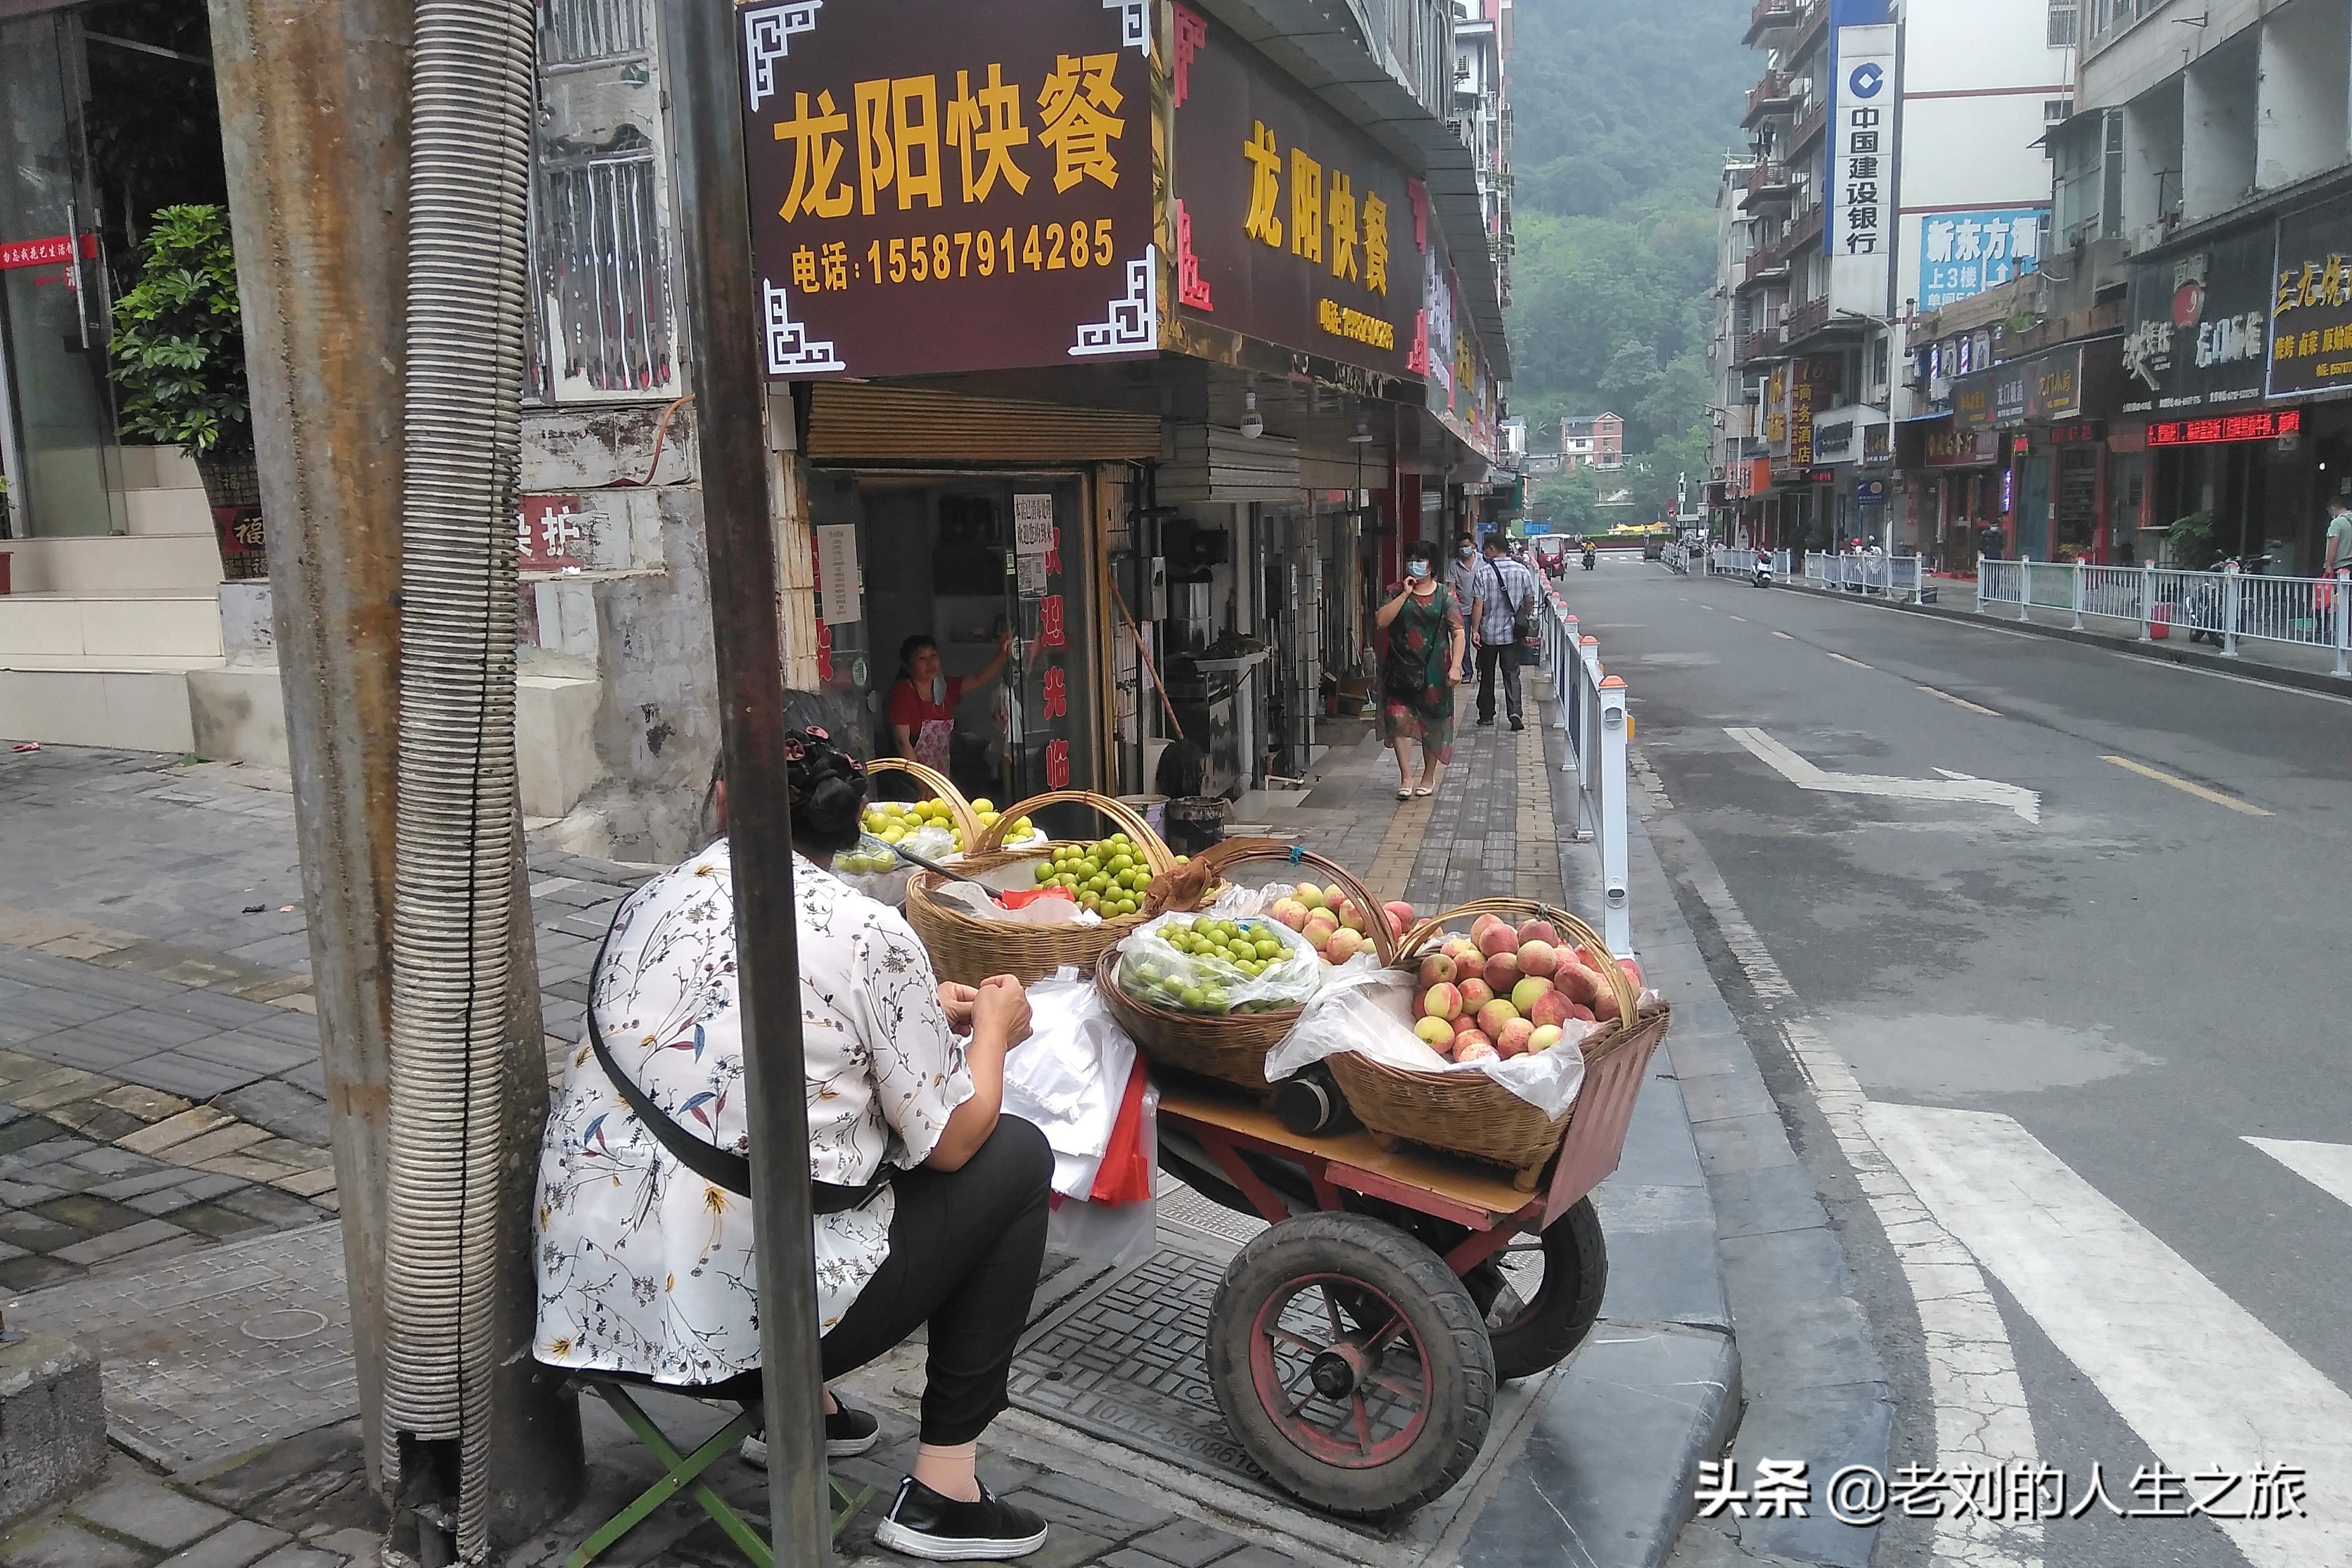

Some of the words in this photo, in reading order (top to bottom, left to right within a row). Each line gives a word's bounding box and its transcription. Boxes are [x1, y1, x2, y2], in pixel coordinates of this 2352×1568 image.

[774, 52, 1126, 223] 龙阳快餐
[1846, 107, 1880, 254] 中国建设银行
[1244, 119, 1389, 296] 龙阳快餐
[1928, 266, 1977, 289] 上3楼
[1797, 384, 1812, 463] 商务酒店
[234, 517, 265, 545] 福
